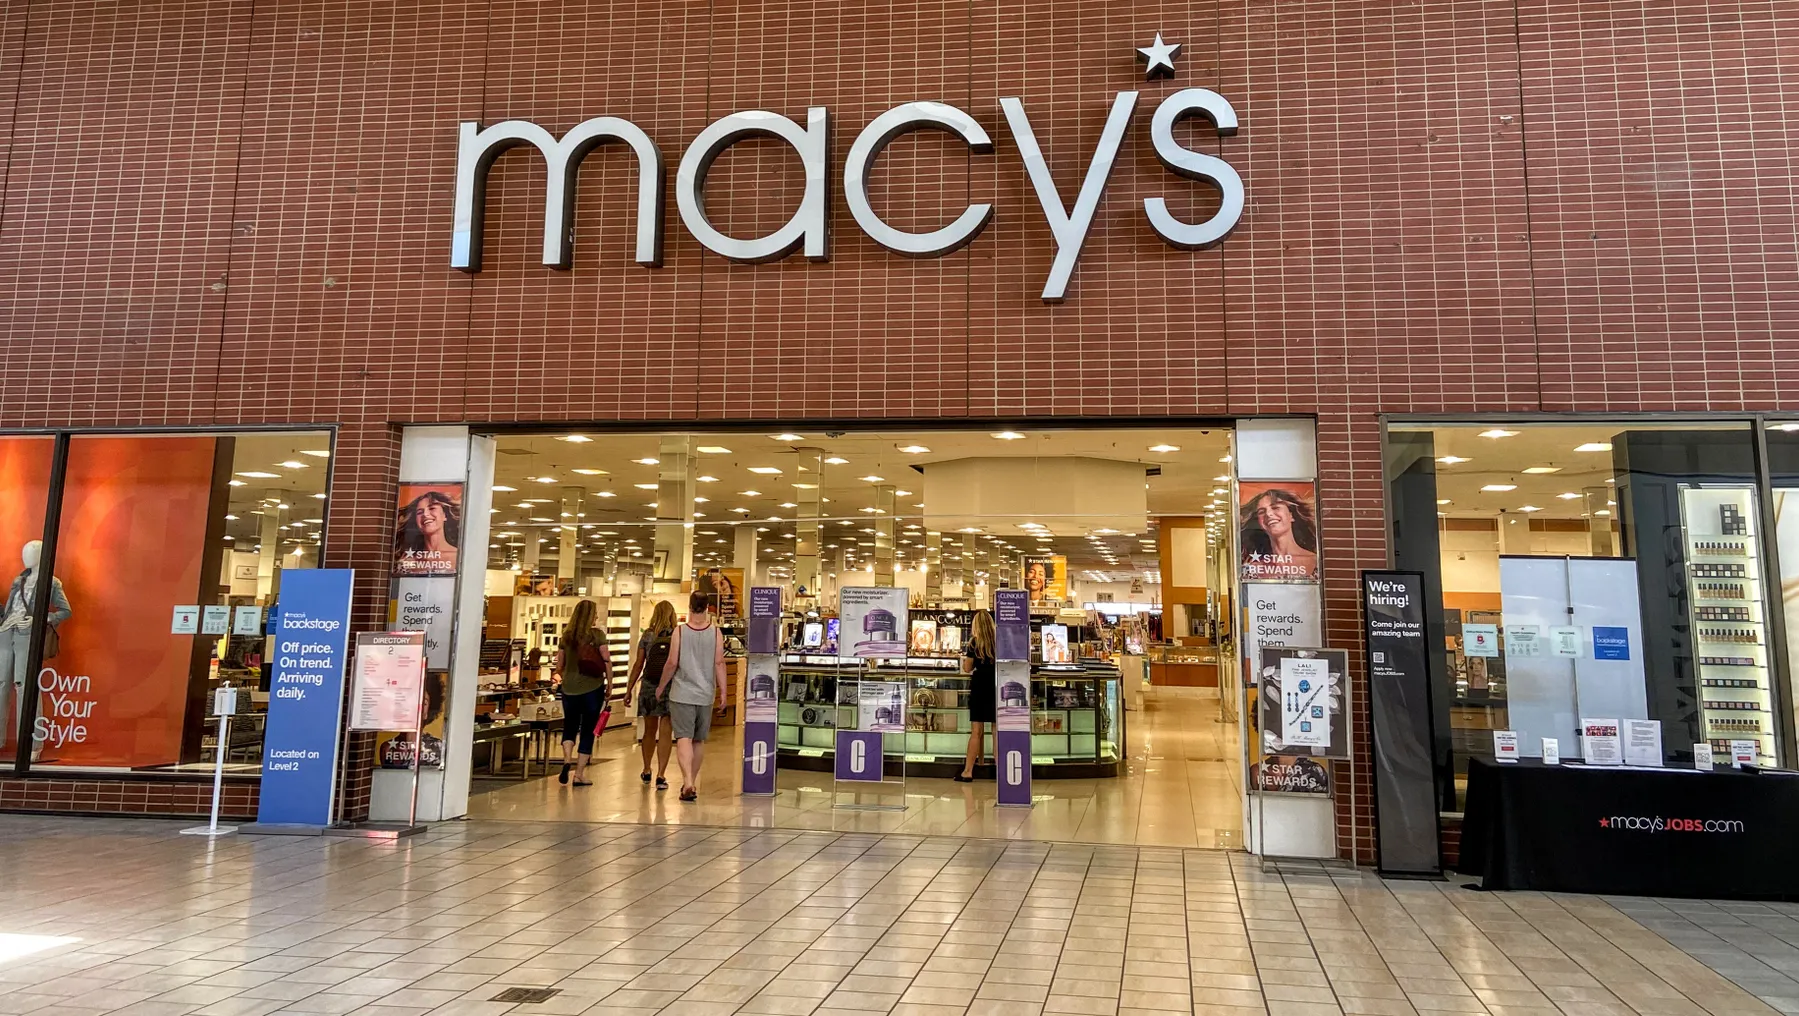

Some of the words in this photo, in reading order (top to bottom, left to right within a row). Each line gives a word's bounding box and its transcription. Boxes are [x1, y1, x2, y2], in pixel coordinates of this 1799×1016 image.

[416, 551, 441, 559] STAR
[1263, 554, 1293, 564] STAR
[402, 561, 452, 569] REWARDS
[1248, 565, 1307, 575] REWARDS
[1368, 580, 1406, 593] We're
[404, 592, 422, 603] Get
[1369, 594, 1410, 608] hiring!
[403, 604, 443, 614] rewards.
[1256, 600, 1277, 611] Get
[402, 615, 433, 627] Spend
[1256, 613, 1304, 624] rewards.
[283, 618, 340, 632] backstage
[1371, 620, 1393, 628] Come
[1393, 621, 1407, 629] join
[1257, 625, 1293, 638] Spend
[1371, 630, 1402, 638] amazing
[281, 641, 300, 653] Off
[301, 642, 334, 656] price.
[388, 646, 394, 655] 2
[280, 656, 297, 668] On
[299, 657, 333, 669] trend.
[37, 667, 91, 693] Own
[278, 671, 323, 686] Arriving
[276, 687, 306, 700] daily.
[49, 692, 98, 718] Your
[31, 716, 88, 749] Style
[270, 748, 306, 759] Located
[307, 751, 320, 759] on
[269, 761, 292, 771] Level
[292, 761, 299, 771] 2
[1272, 764, 1303, 775] STAR
